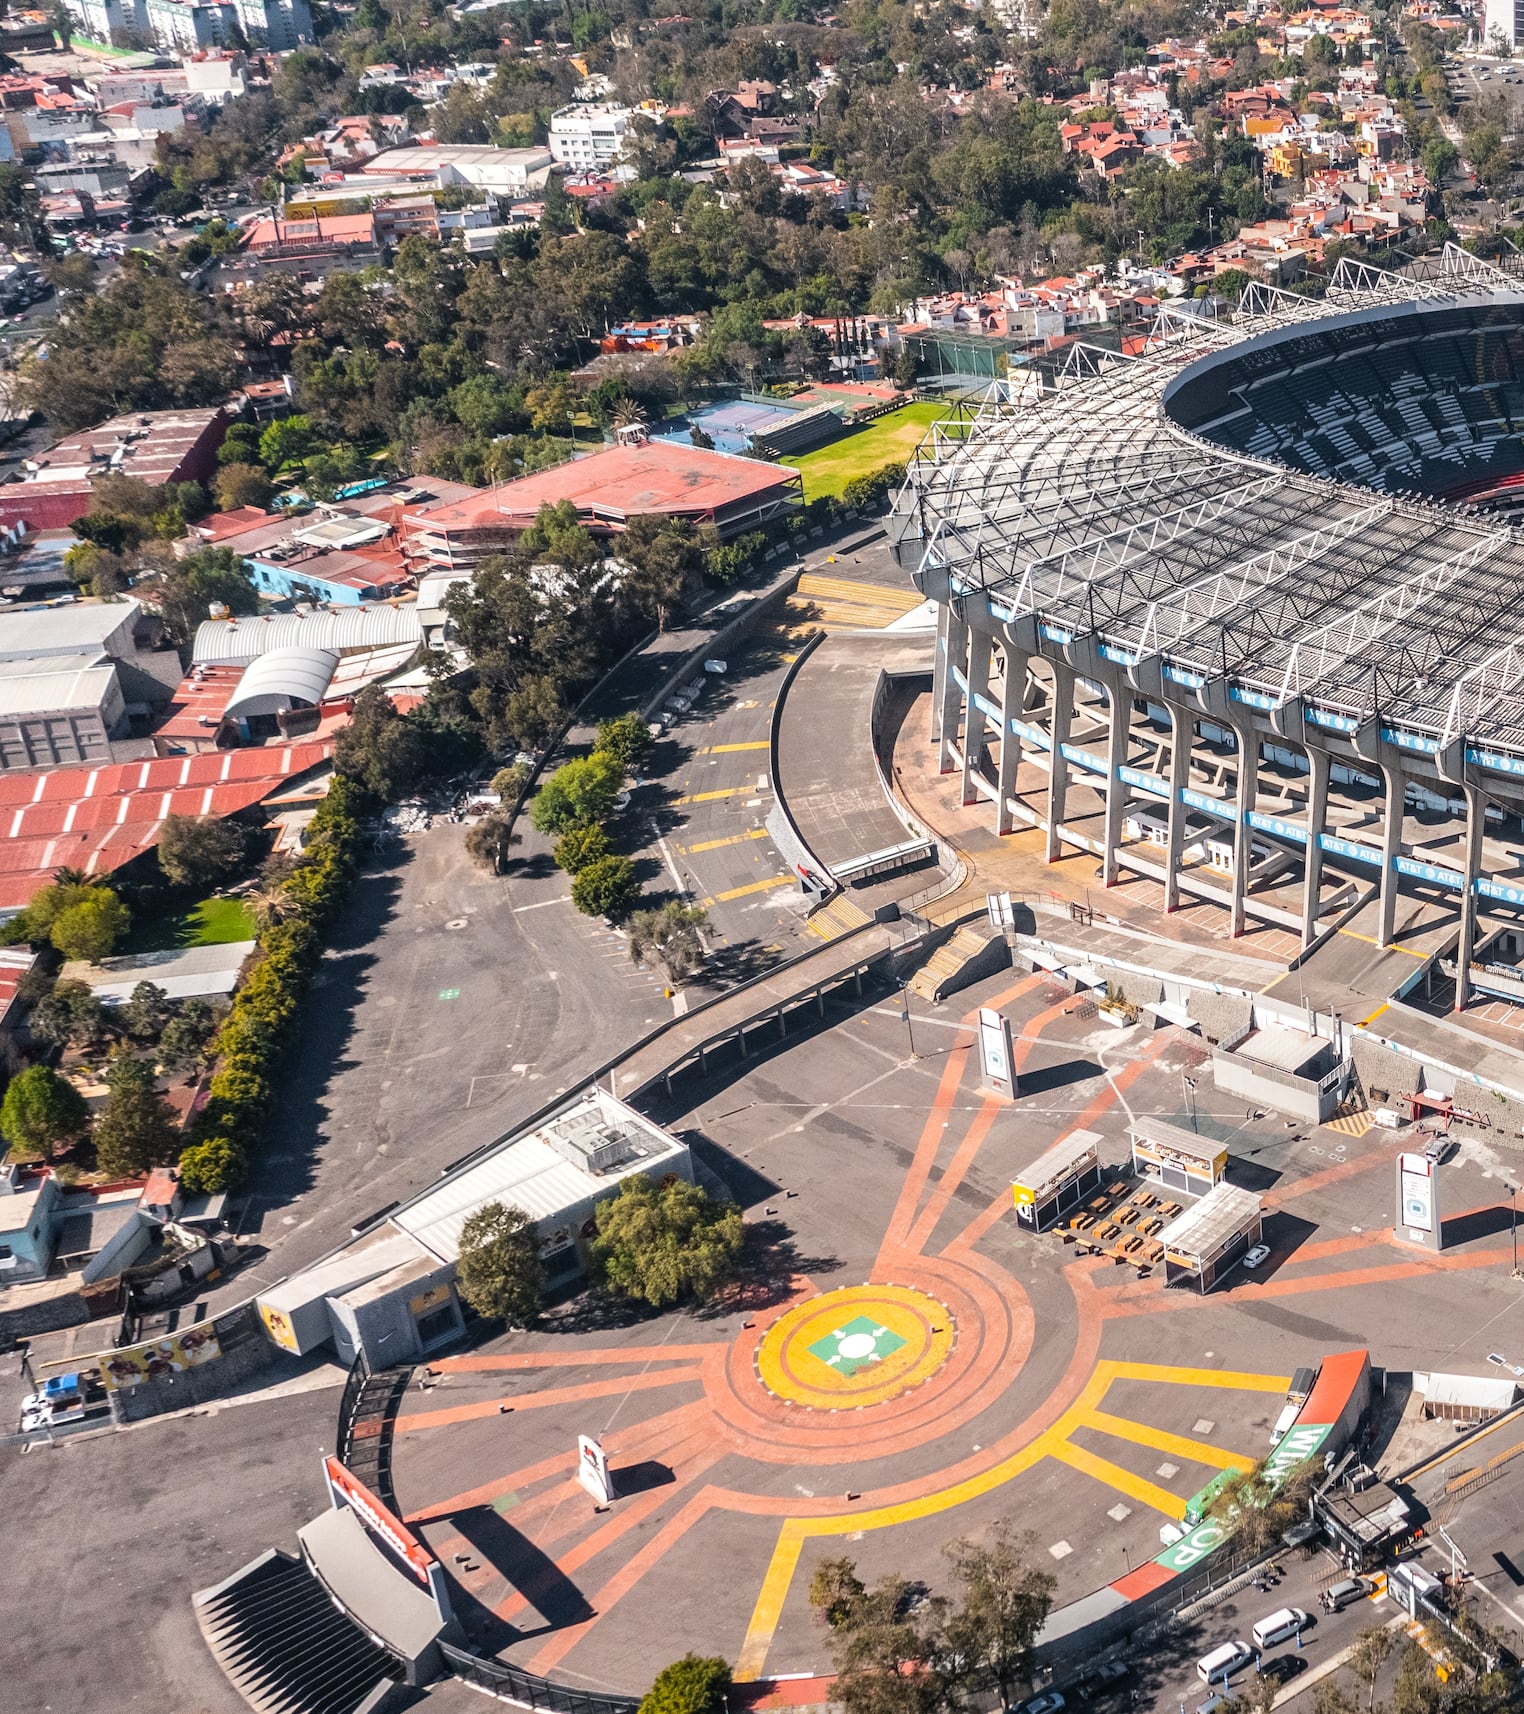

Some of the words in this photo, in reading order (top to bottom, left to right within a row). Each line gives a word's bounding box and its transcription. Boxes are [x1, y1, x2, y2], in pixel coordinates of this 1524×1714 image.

[1308, 708, 1332, 726] AT&T
[1387, 729, 1412, 747] AT&T
[1471, 749, 1496, 768] AT&T
[1185, 792, 1204, 807] AT&T
[1217, 804, 1237, 820] AT&T
[1252, 815, 1272, 830] AT&T
[1285, 826, 1308, 842] AT&T
[1323, 838, 1346, 853] AT&T
[1358, 848, 1383, 864] AT&T
[1399, 861, 1423, 877] AT&T
[1437, 871, 1463, 887] AT&T
[1478, 882, 1505, 898] AT&T
